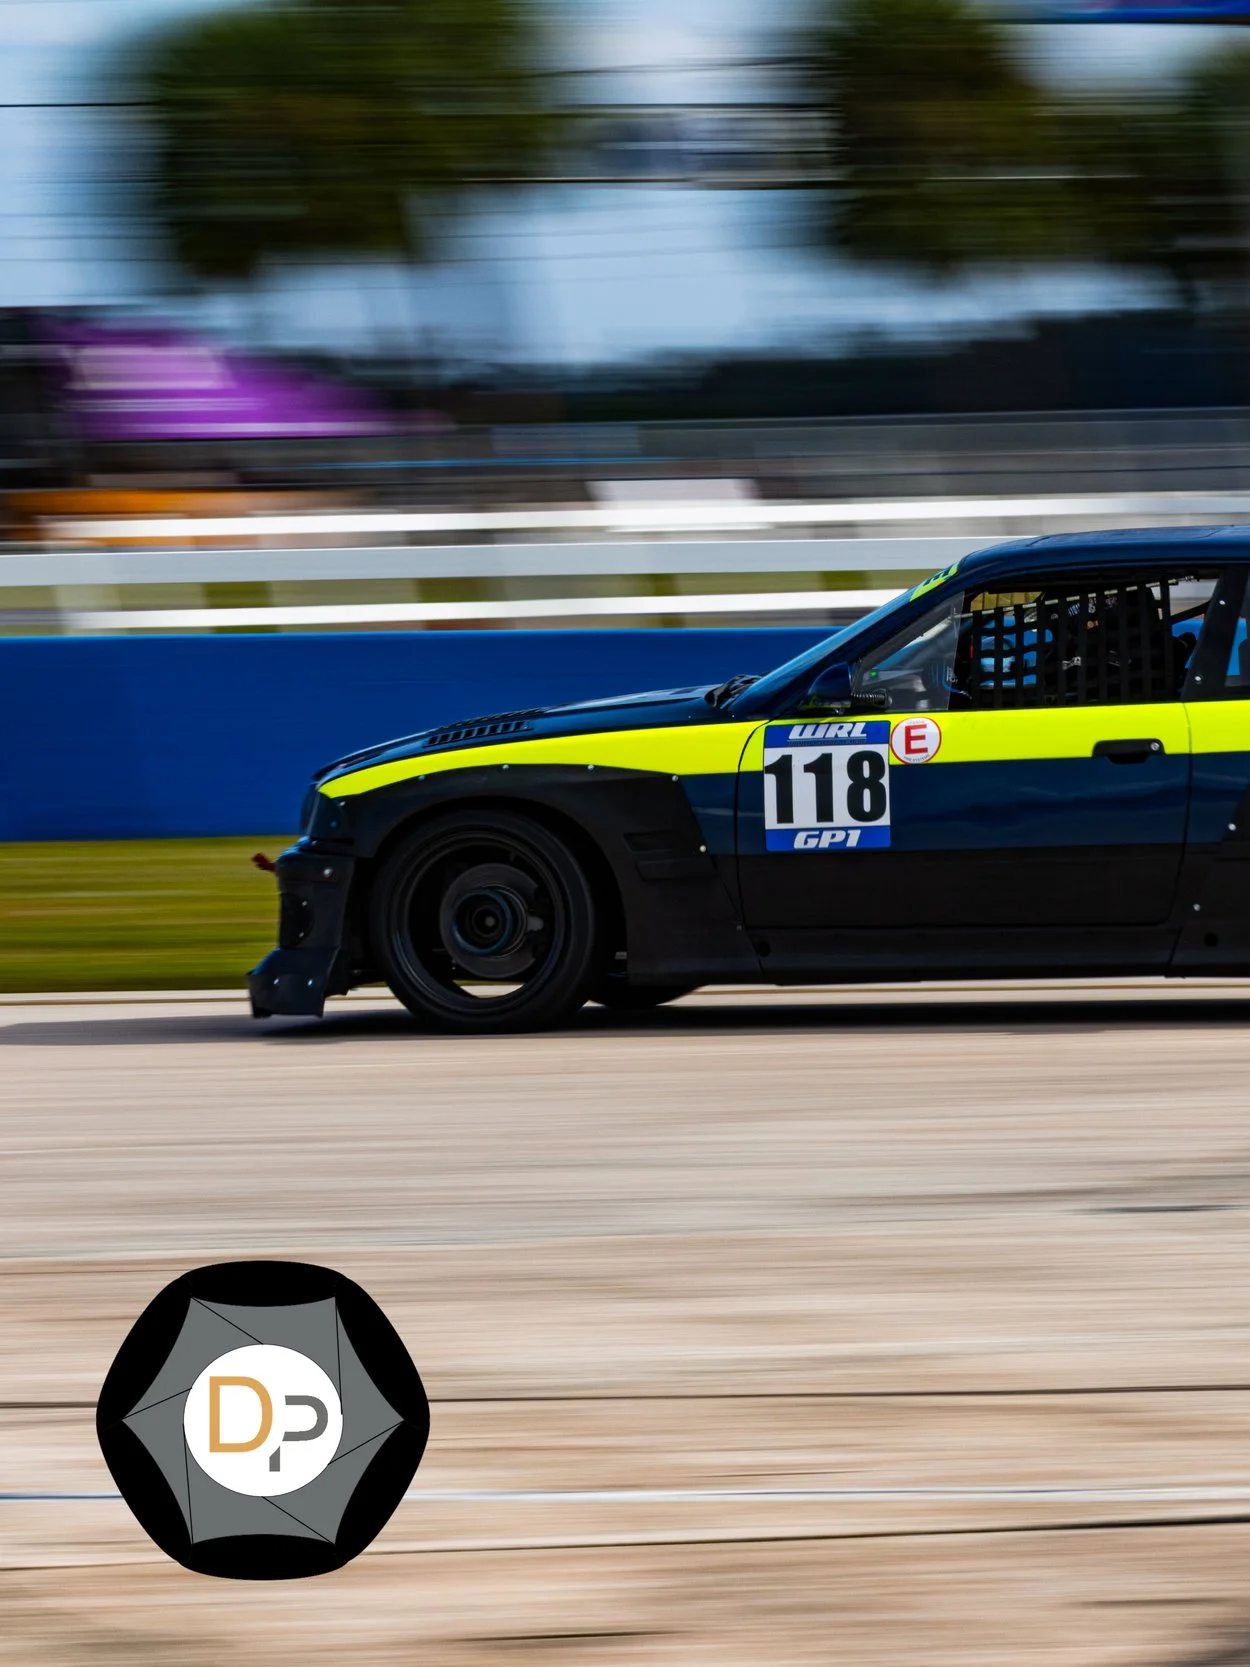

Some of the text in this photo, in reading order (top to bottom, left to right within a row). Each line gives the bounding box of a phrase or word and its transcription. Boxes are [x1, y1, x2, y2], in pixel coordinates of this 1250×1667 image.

[788, 722, 867, 739] WRL
[905, 724, 928, 755] E
[765, 750, 887, 824] 118
[793, 829, 862, 849] GP1
